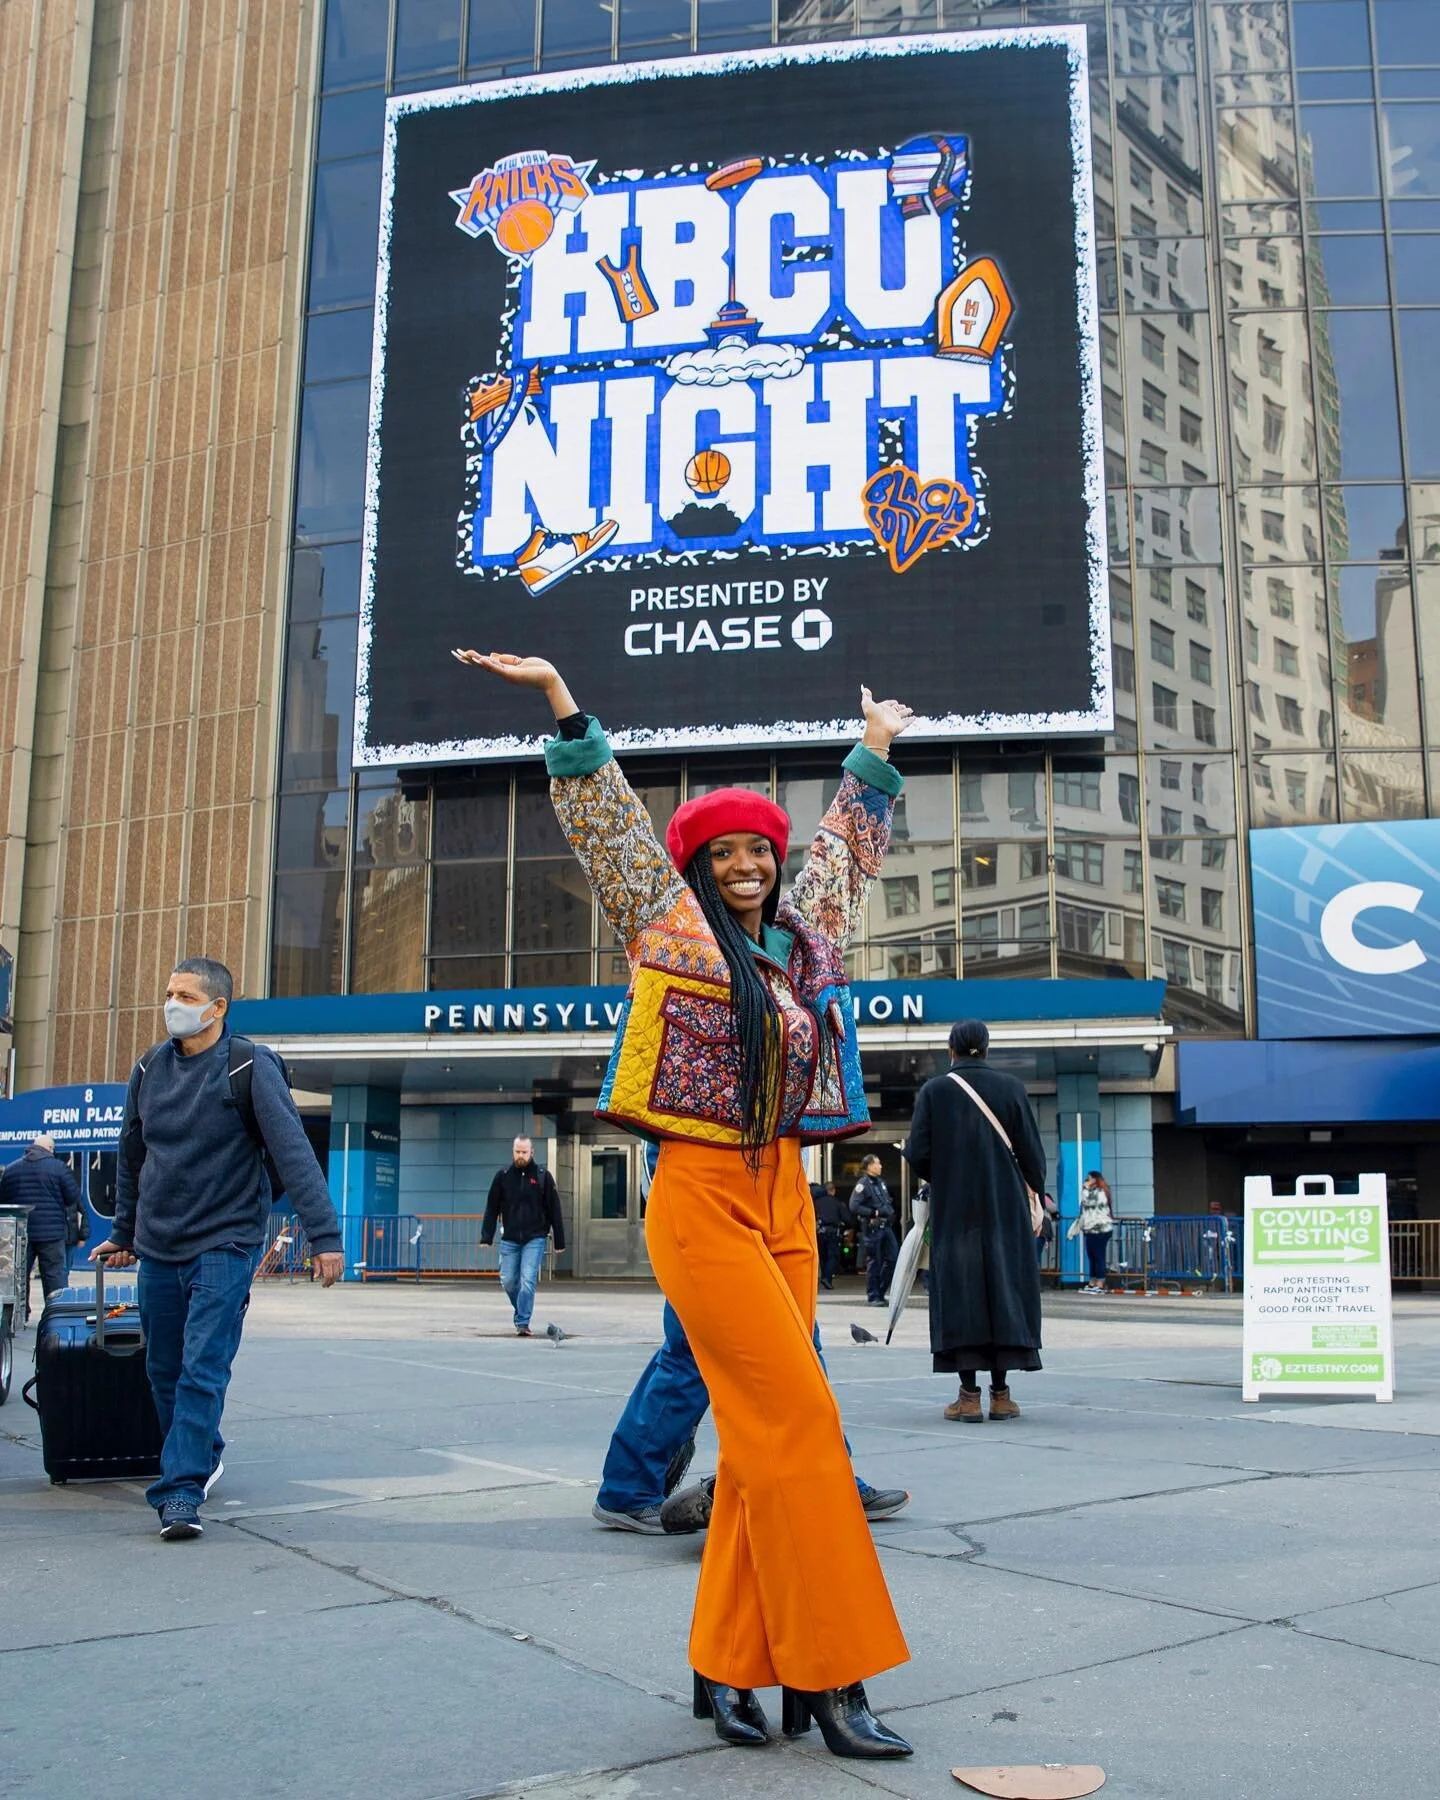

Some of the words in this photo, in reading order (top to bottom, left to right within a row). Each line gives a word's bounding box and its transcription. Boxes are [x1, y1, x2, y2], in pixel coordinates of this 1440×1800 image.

[520, 154, 547, 166] YORK
[461, 158, 589, 225] KNICKS
[522, 169, 945, 360] HBCU
[482, 354, 992, 557] NIGHT
[865, 470, 969, 526] BLACK
[868, 506, 959, 568] LOVE
[630, 580, 785, 612] PRESENTED
[793, 577, 829, 602] BY
[624, 615, 783, 657] CHASE
[424, 1001, 624, 1029] PENNSYLV
[853, 994, 924, 1020] ION
[84, 1087, 94, 1103] 8
[43, 1108, 80, 1124] PENN
[86, 1106, 124, 1122] PLAZ
[46, 1128, 72, 1140] MEDIA
[74, 1127, 92, 1139] AND
[93, 1126, 123, 1138] PATRO
[1259, 1208, 1373, 1228] COVID-19
[1263, 1227, 1370, 1246] TESTING
[1263, 1286, 1294, 1294] RAPID
[1297, 1286, 1343, 1294] ANTIGEN
[1345, 1285, 1371, 1293] TEST
[1283, 1276, 1304, 1285] PCR
[1307, 1276, 1350, 1284] TESTING
[1258, 1305, 1289, 1313] GOOD
[1291, 1305, 1312, 1313] FOR
[1336, 1304, 1376, 1313] TRAVEL
[1294, 1295, 1309, 1304] NO
[1311, 1295, 1340, 1303] COST
[1285, 1363, 1379, 1375] EZTESTNY.COM
